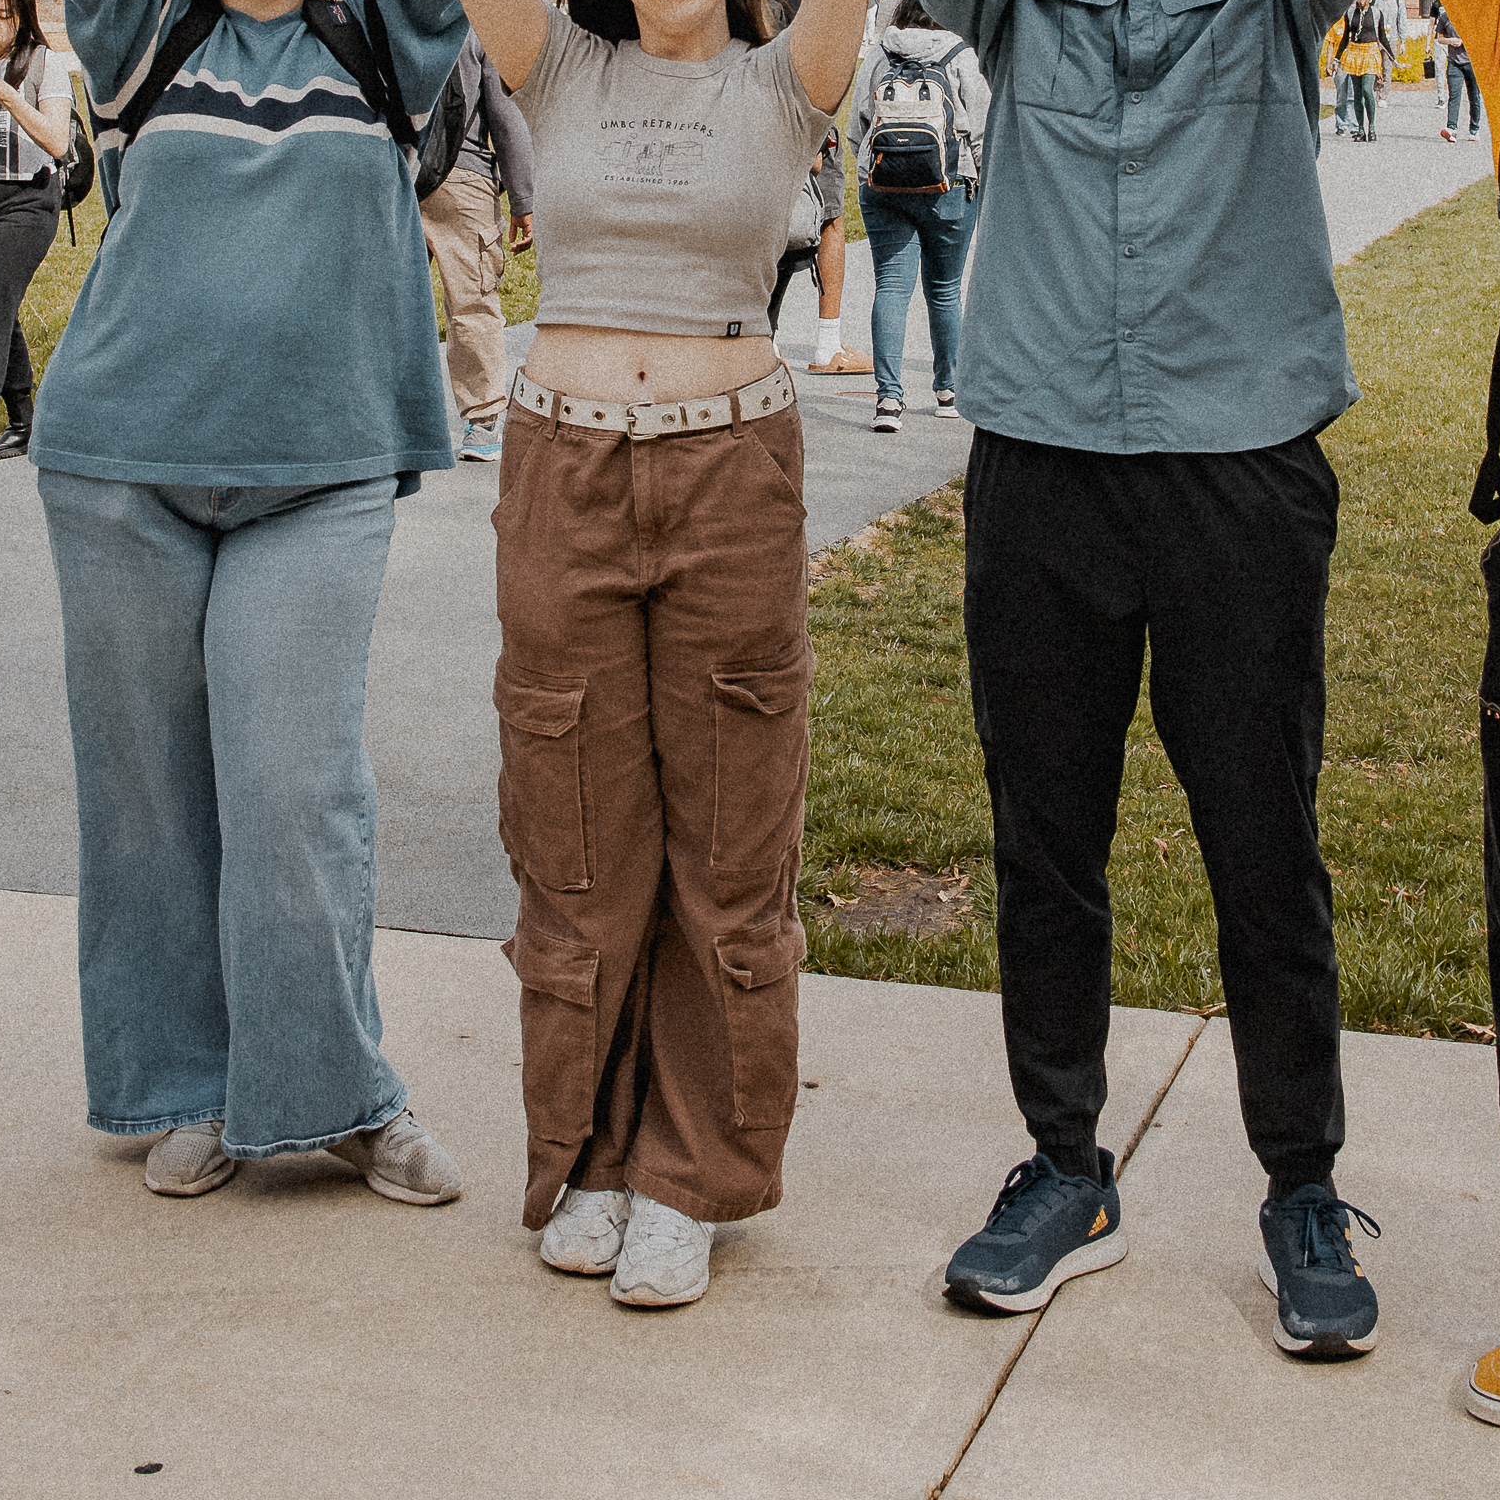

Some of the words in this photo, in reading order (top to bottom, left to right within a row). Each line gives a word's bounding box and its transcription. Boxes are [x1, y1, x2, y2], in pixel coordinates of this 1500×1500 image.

[600, 120, 637, 130] UMBC
[642, 118, 714, 138] RETRIEVERS
[604, 174, 664, 185] ESTABLISHED
[730, 323, 739, 336] U
